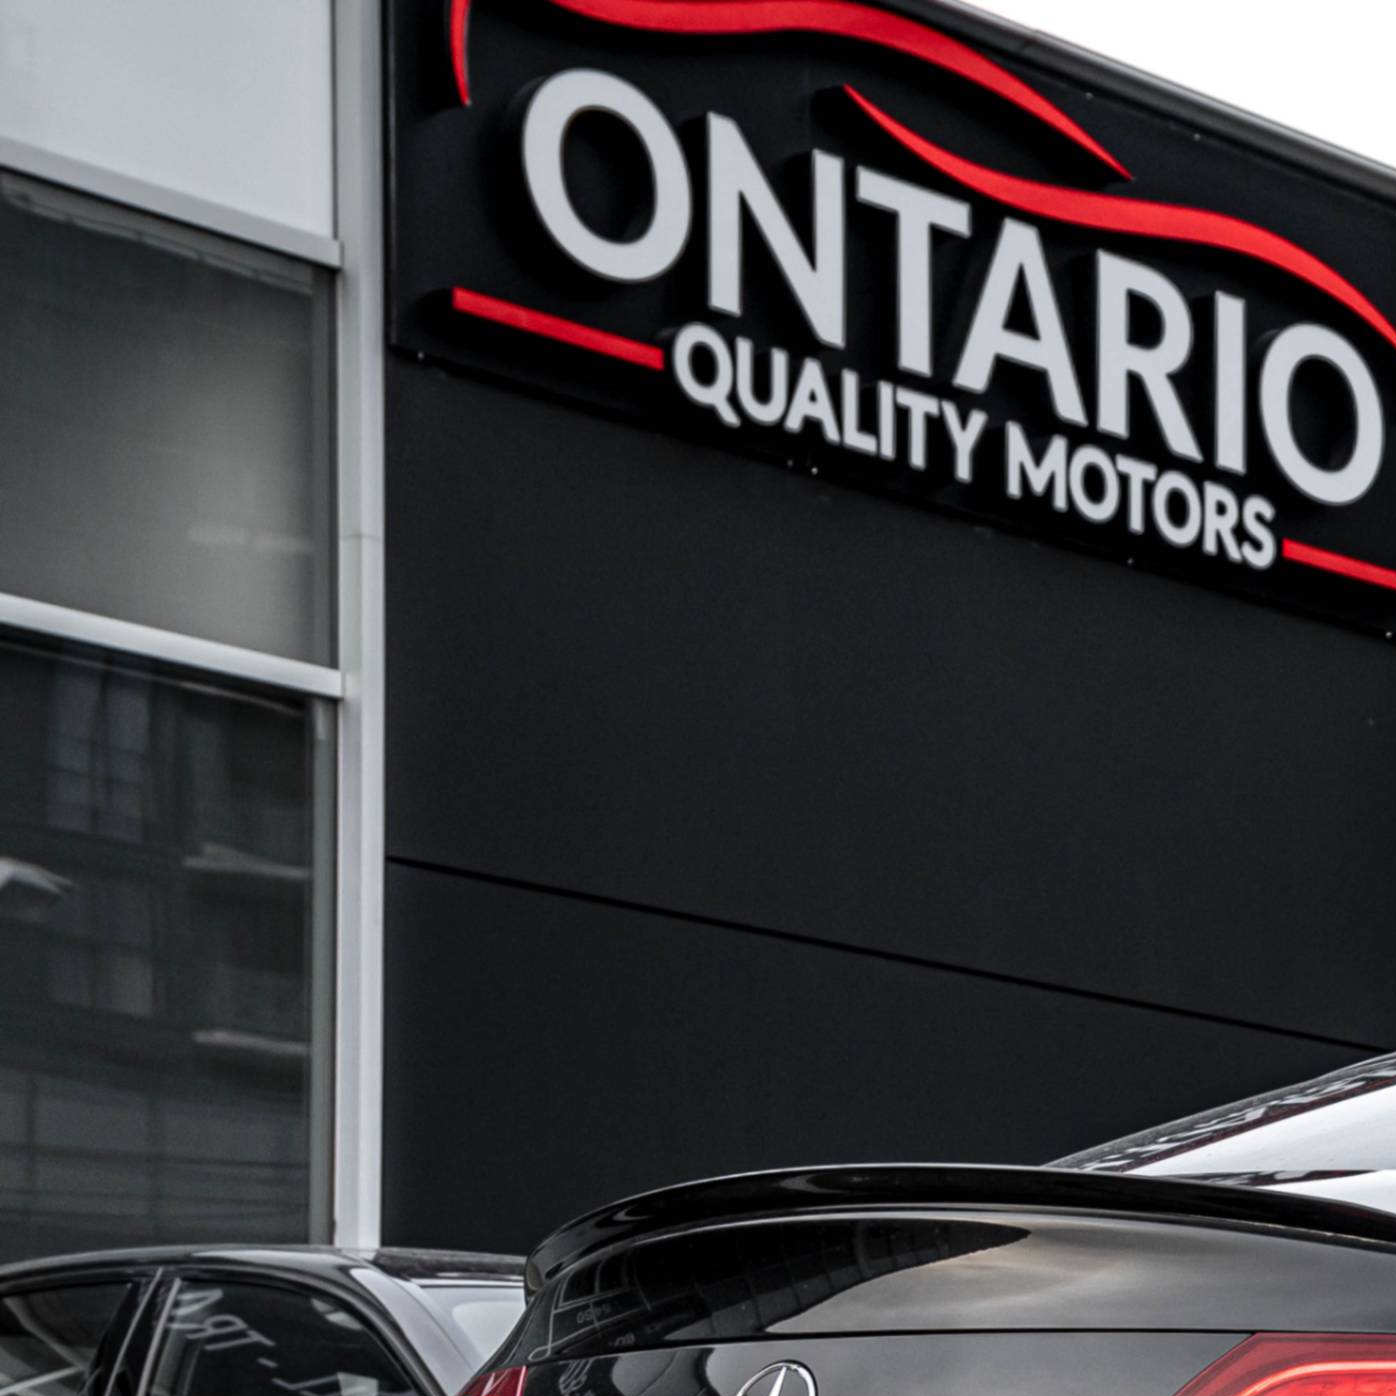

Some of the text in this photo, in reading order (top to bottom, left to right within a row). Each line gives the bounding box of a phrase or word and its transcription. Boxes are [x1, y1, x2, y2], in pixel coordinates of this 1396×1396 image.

[522, 68, 1384, 505] ONTARIO
[672, 322, 1276, 570] QUALITY MOTORS
